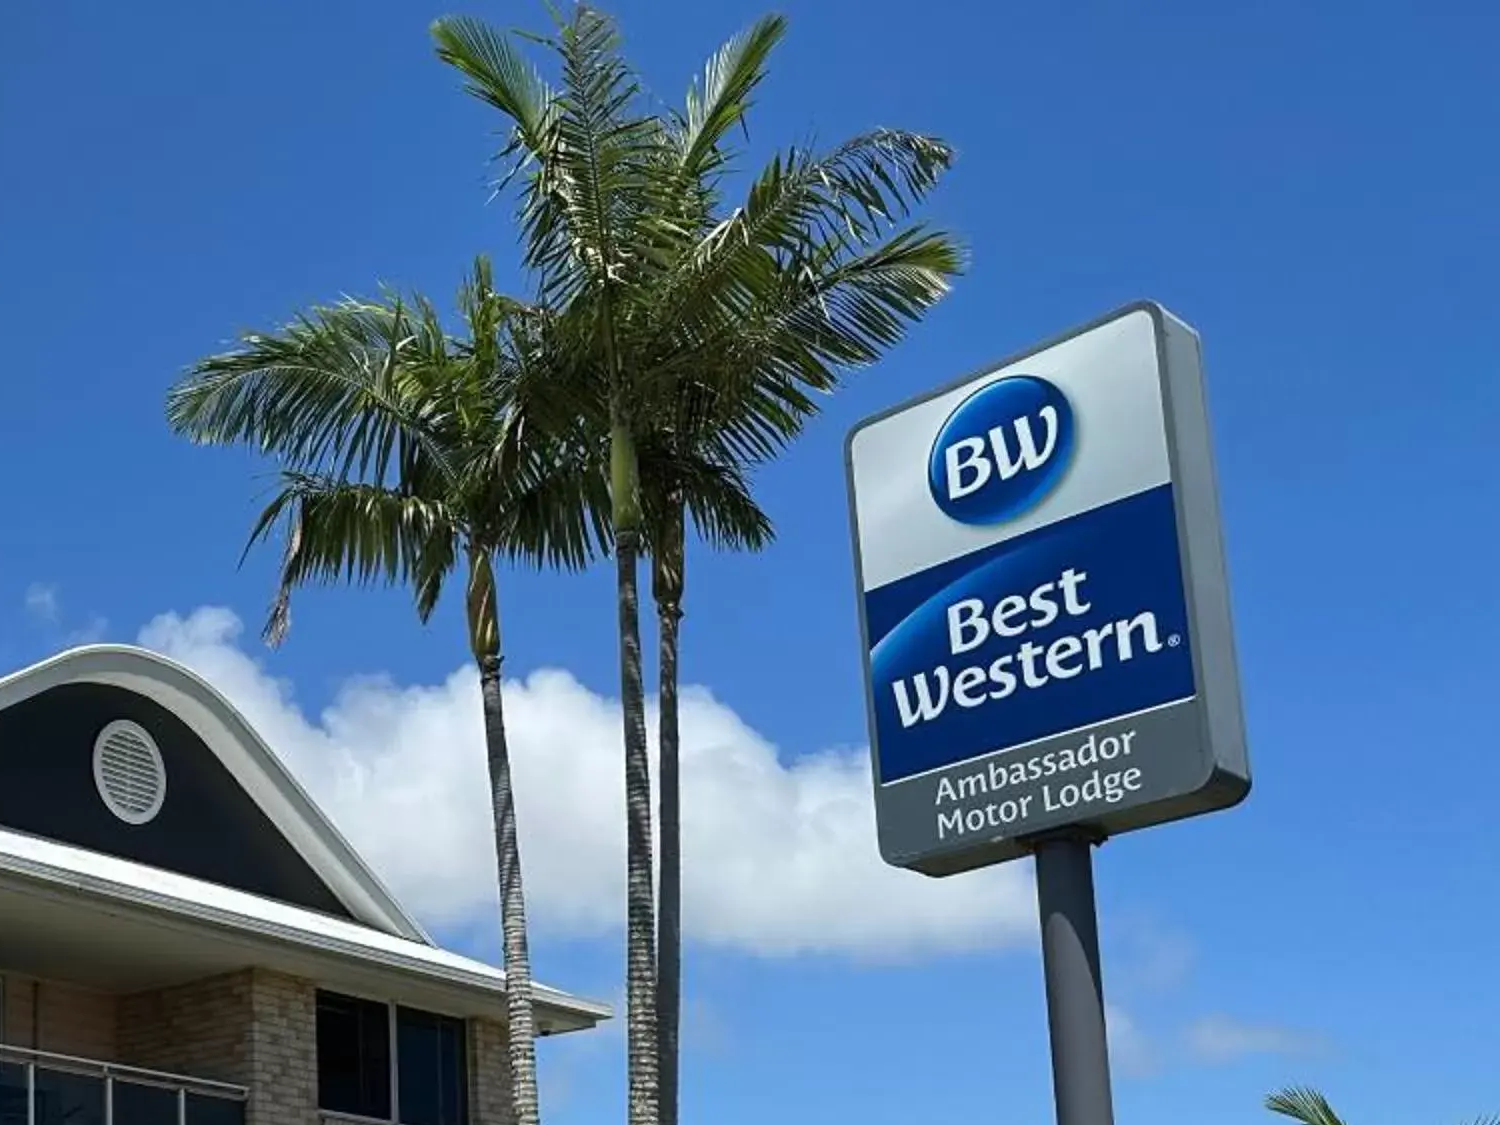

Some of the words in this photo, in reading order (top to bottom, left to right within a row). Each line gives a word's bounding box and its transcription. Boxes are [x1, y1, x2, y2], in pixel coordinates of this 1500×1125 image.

[945, 405, 1060, 501] BW
[947, 566, 1092, 655] Best
[935, 729, 1137, 805] Ambassador
[937, 789, 1033, 841] Motor
[1043, 763, 1141, 812] Lodge
